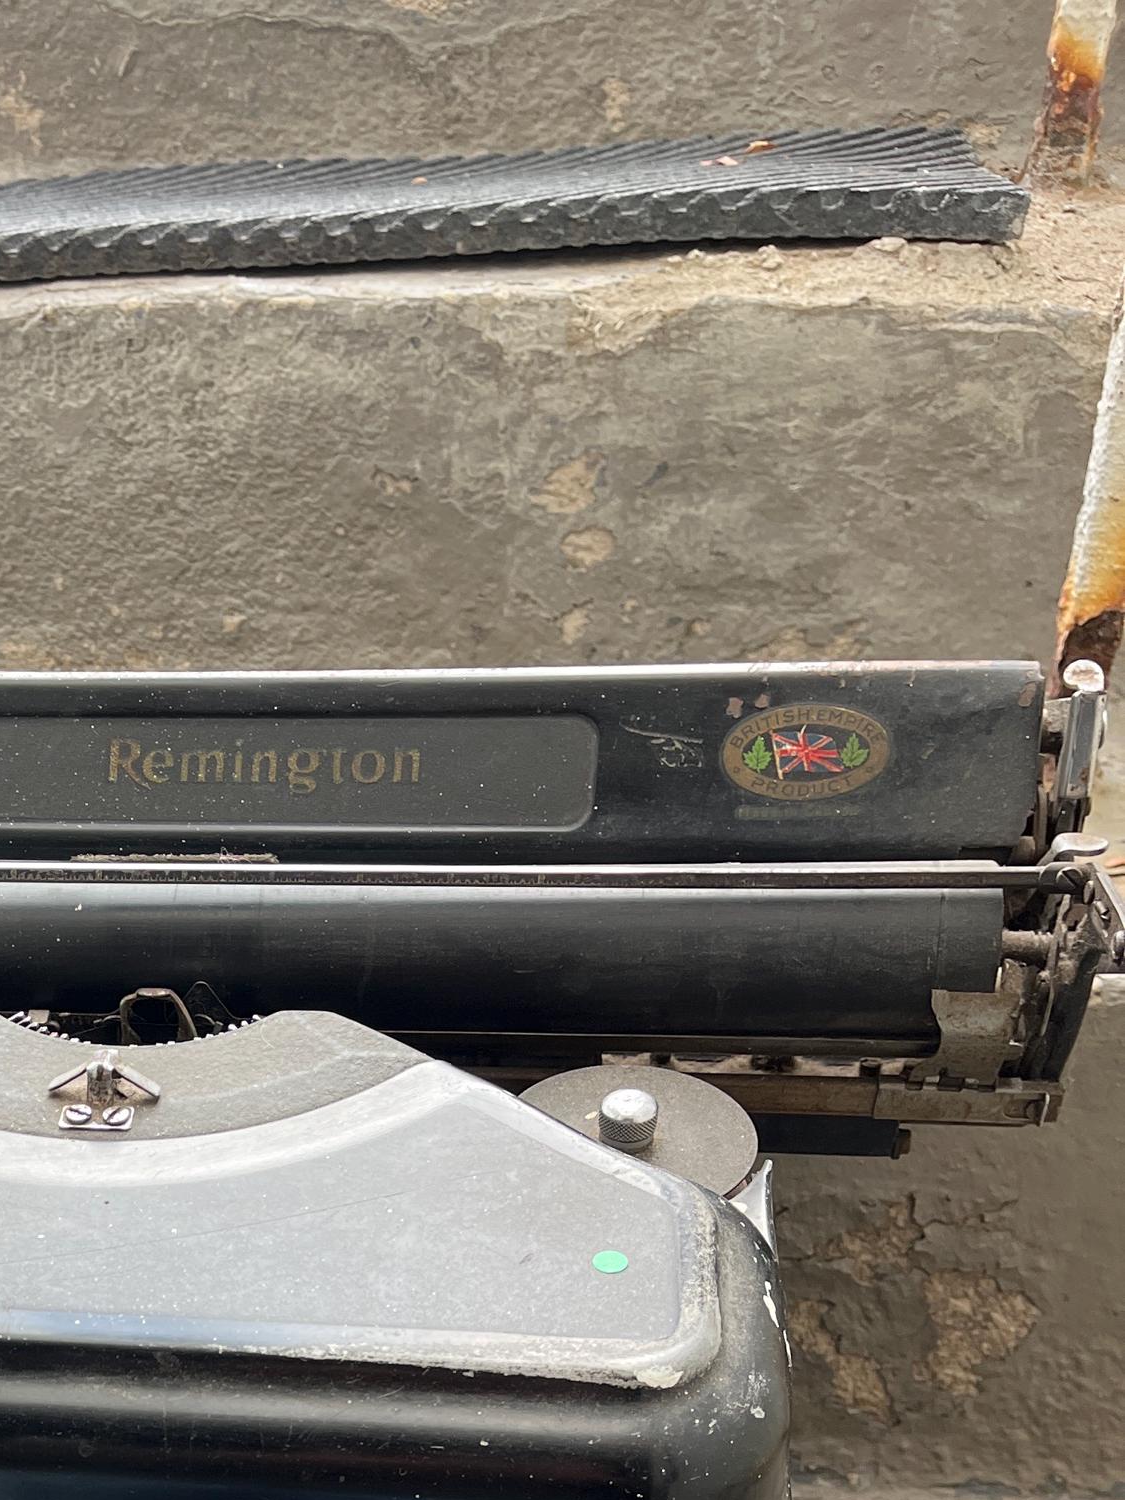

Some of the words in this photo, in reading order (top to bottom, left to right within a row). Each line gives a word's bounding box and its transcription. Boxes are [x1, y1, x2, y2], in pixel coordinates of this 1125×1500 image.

[730, 709, 811, 749] BRITISH
[817, 709, 887, 745] EMPIRE
[108, 737, 421, 795] Remington
[750, 775, 855, 797] PRODUCT
